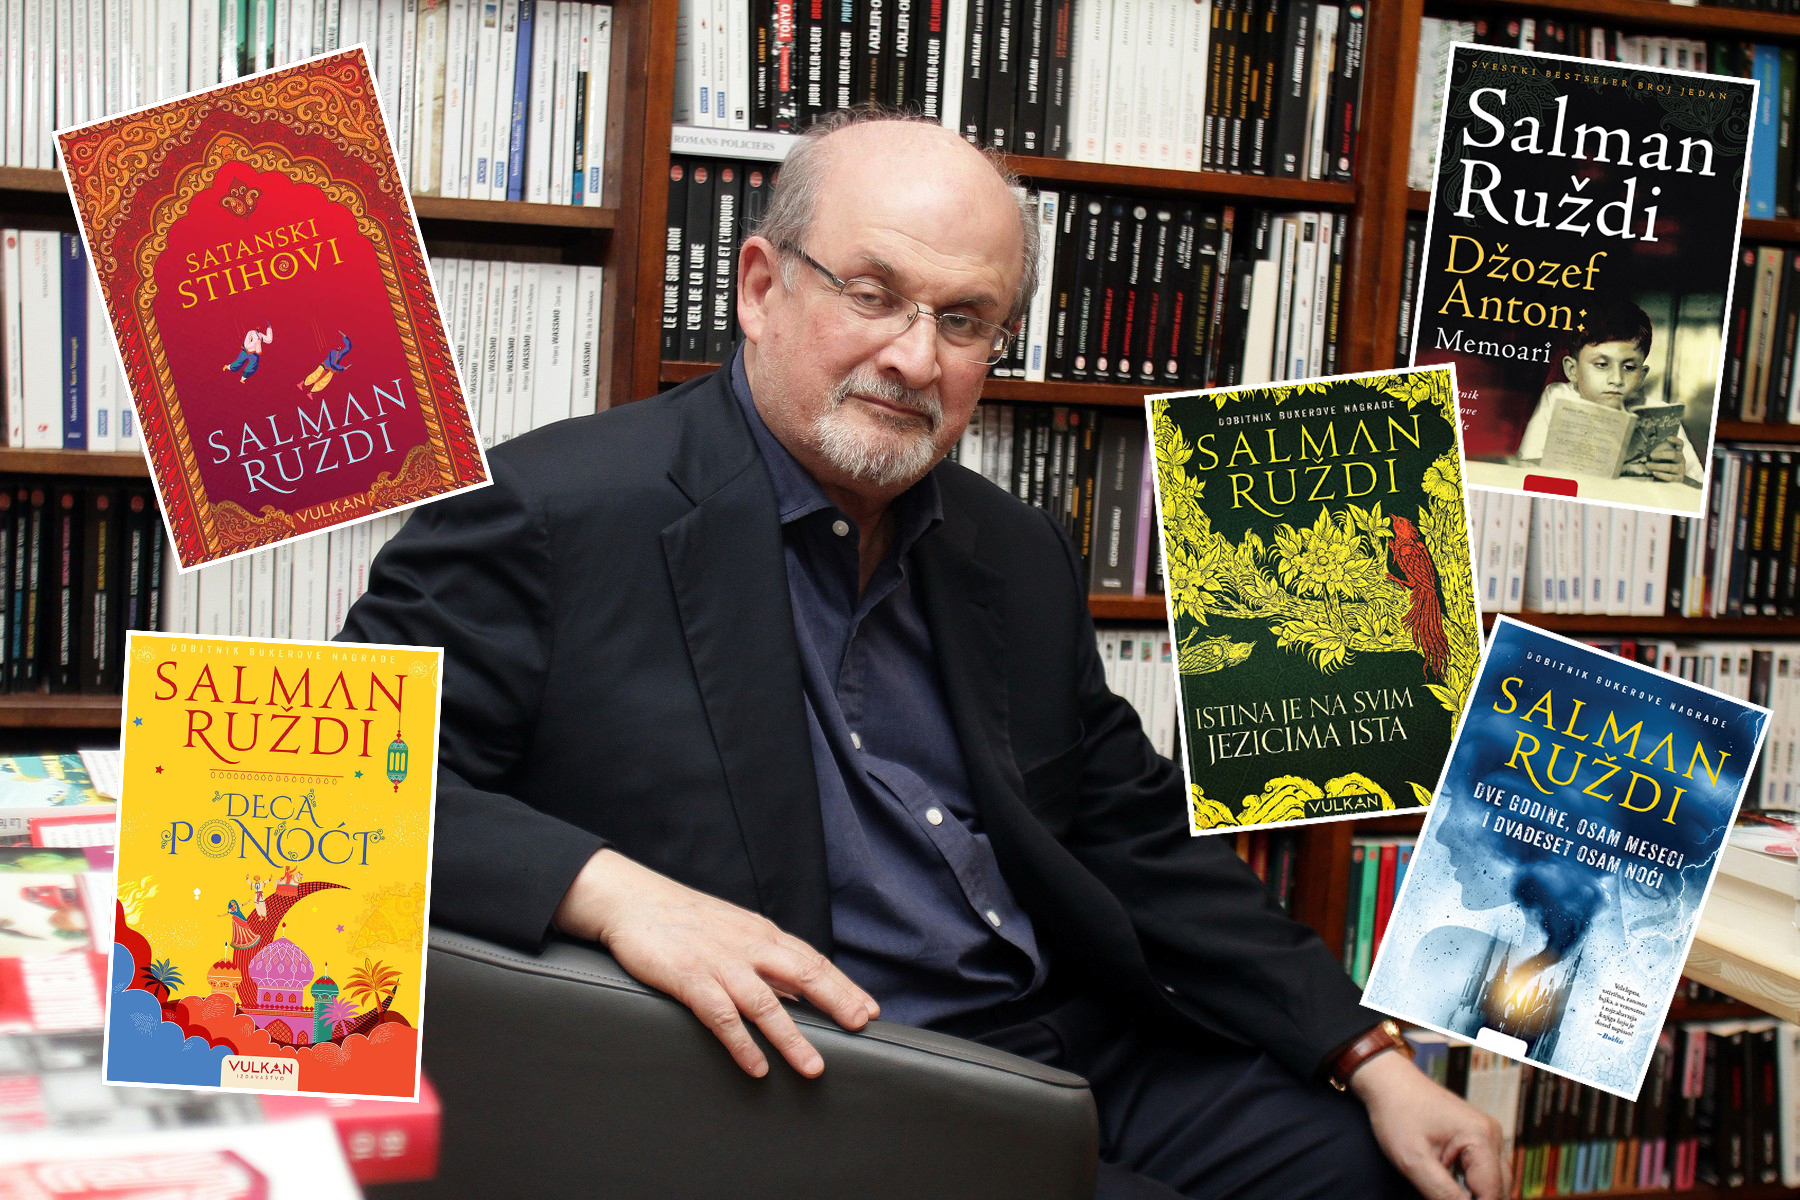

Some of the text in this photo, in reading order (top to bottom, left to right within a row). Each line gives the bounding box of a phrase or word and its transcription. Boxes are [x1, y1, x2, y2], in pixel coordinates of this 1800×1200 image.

[780, 4, 791, 37] TOKYO
[673, 134, 776, 152] ROMANS POLICIERS
[690, 244, 705, 269] LUNE
[663, 227, 682, 329] LE LIVRE SANS NOM
[689, 272, 704, 285] LA
[716, 278, 729, 288] LE
[550, 310, 560, 345] WASSMO
[714, 319, 727, 330] LE
[487, 337, 497, 373] WASSMO
[505, 337, 515, 373] WASSMO
[521, 335, 531, 370] WASSMO
[581, 342, 591, 377] WASSMO
[469, 362, 478, 395] WASSMO
